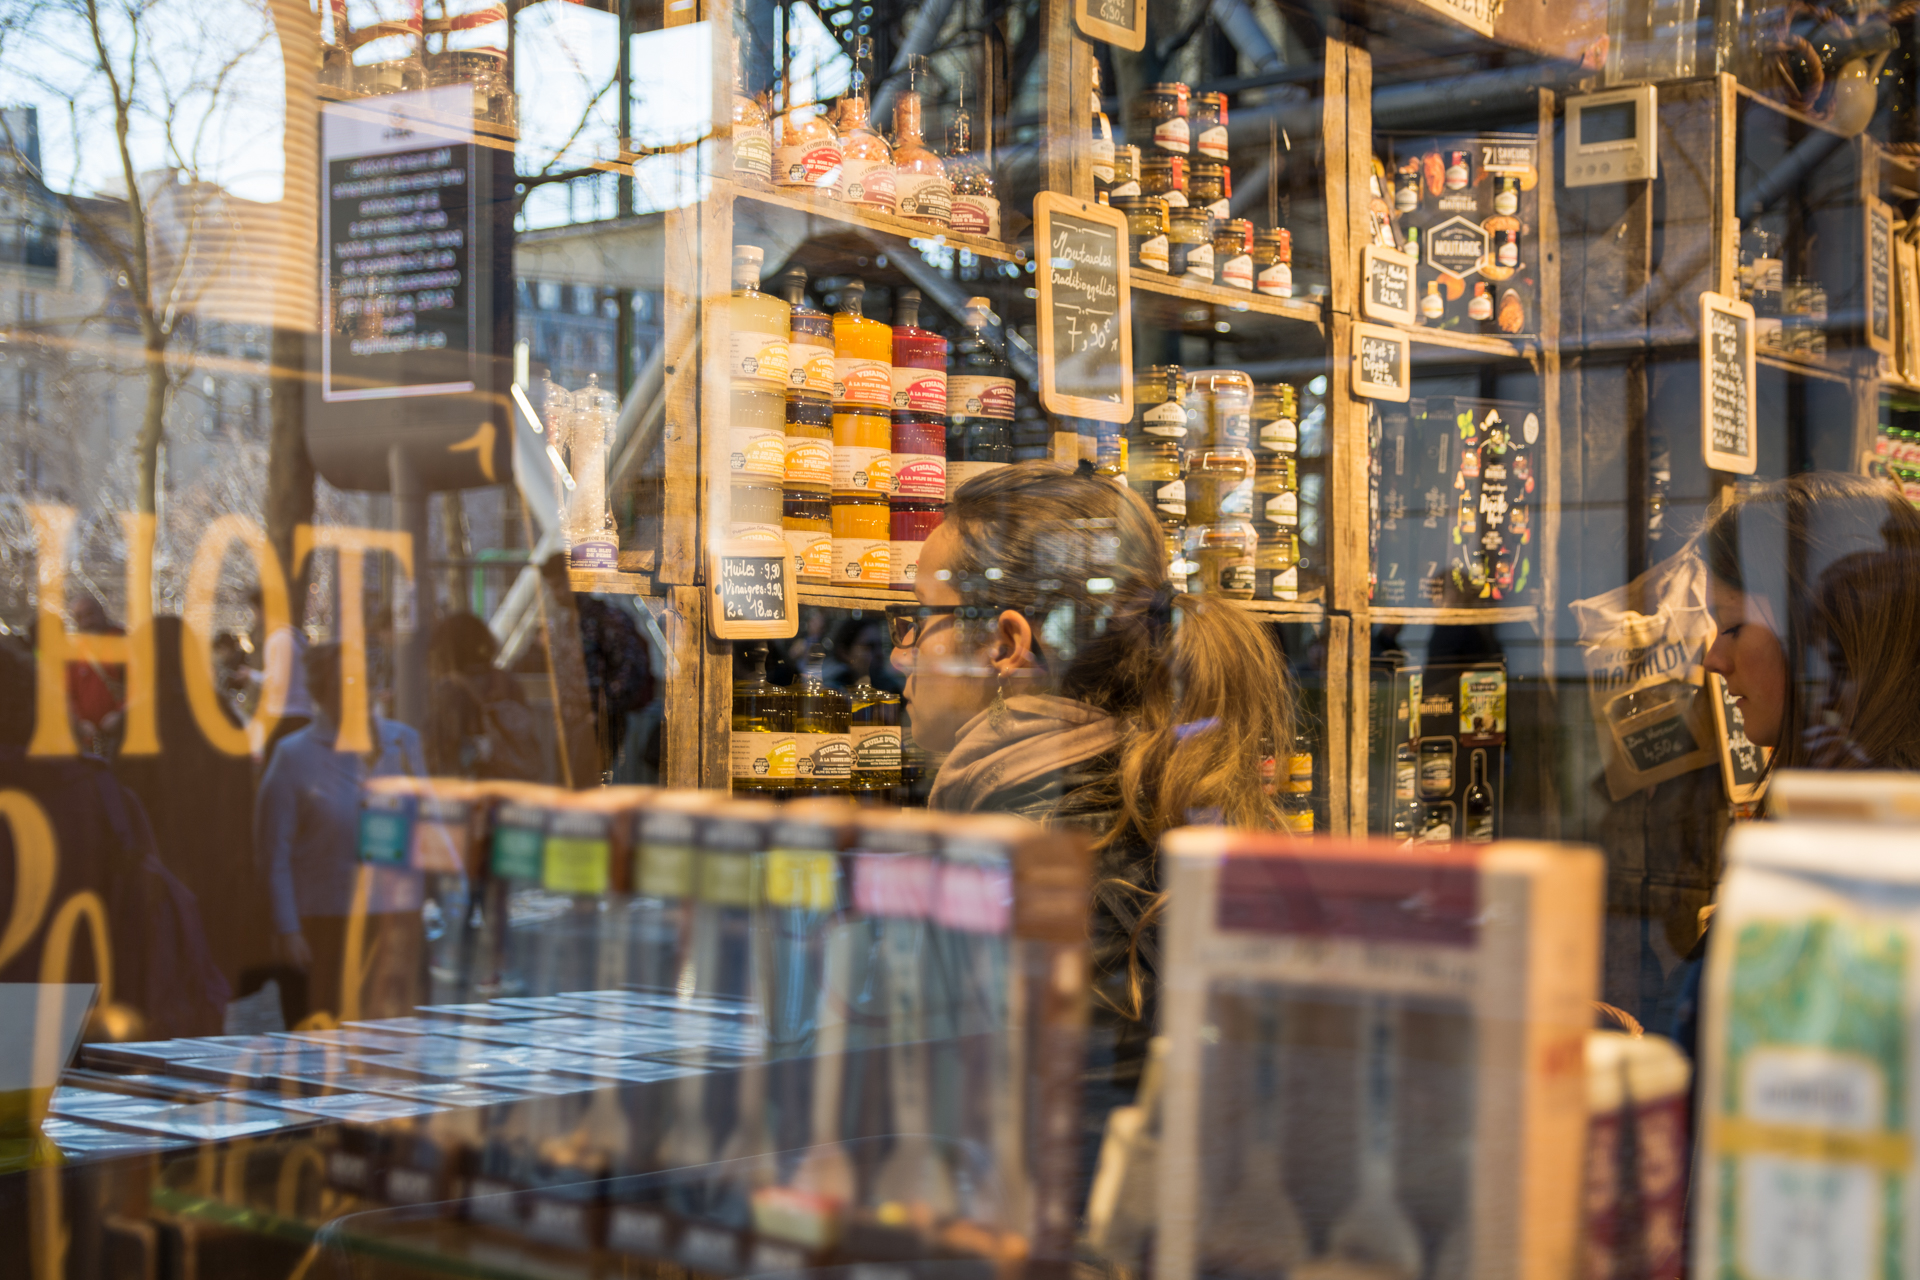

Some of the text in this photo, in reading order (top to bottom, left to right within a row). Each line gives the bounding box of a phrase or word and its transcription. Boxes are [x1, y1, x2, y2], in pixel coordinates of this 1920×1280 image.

[1100, 3, 1125, 25] 6,90€
[1482, 147, 1493, 165] 7
[1053, 231, 1112, 267] Moutardes
[1434, 240, 1482, 257] MOUTARDE
[1051, 263, 1115, 302] traditionnelles
[1066, 316, 1112, 352] 7,90€
[723, 559, 755, 577] Huiles
[727, 601, 736, 617] 2
[27, 505, 413, 757] HOT
[774, 744, 791, 756] HUILE
[819, 744, 838, 756] HUILE
[862, 736, 884, 748] HUILE
